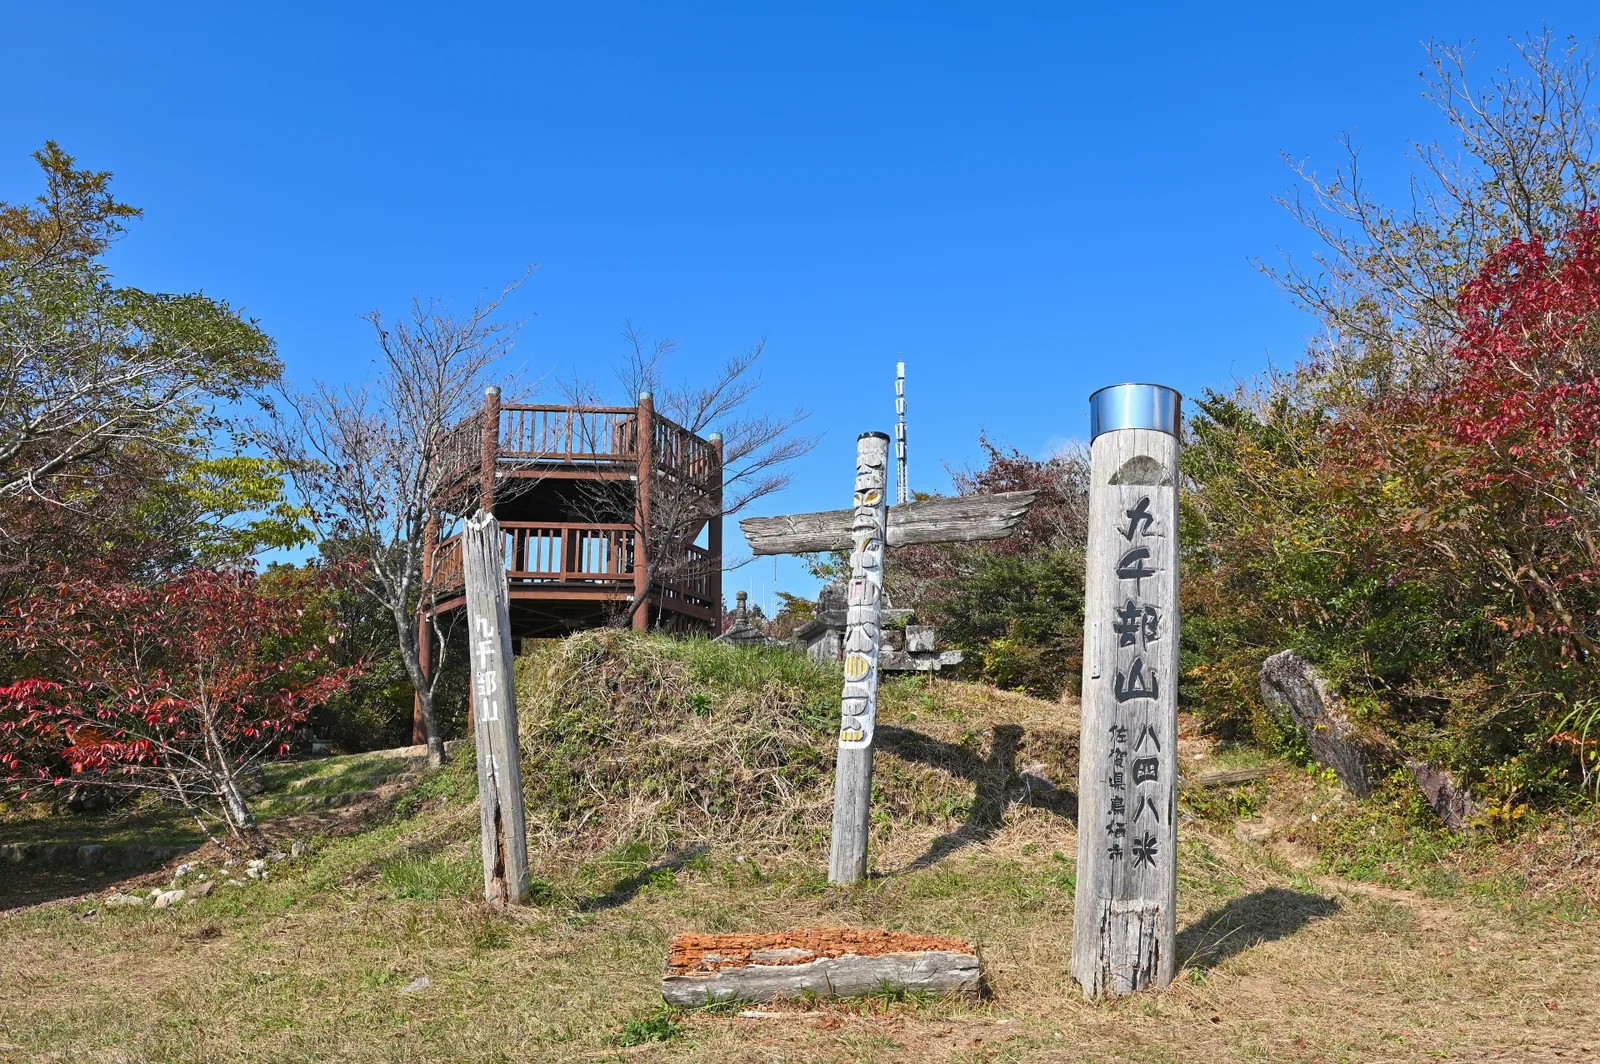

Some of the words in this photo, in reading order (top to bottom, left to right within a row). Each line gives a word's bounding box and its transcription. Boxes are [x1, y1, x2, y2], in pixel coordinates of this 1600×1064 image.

[1113, 495, 1165, 703] 九千部山
[1105, 724, 1128, 861] 佐賀県鳥栖市
[1132, 723, 1161, 869] 八四八米
